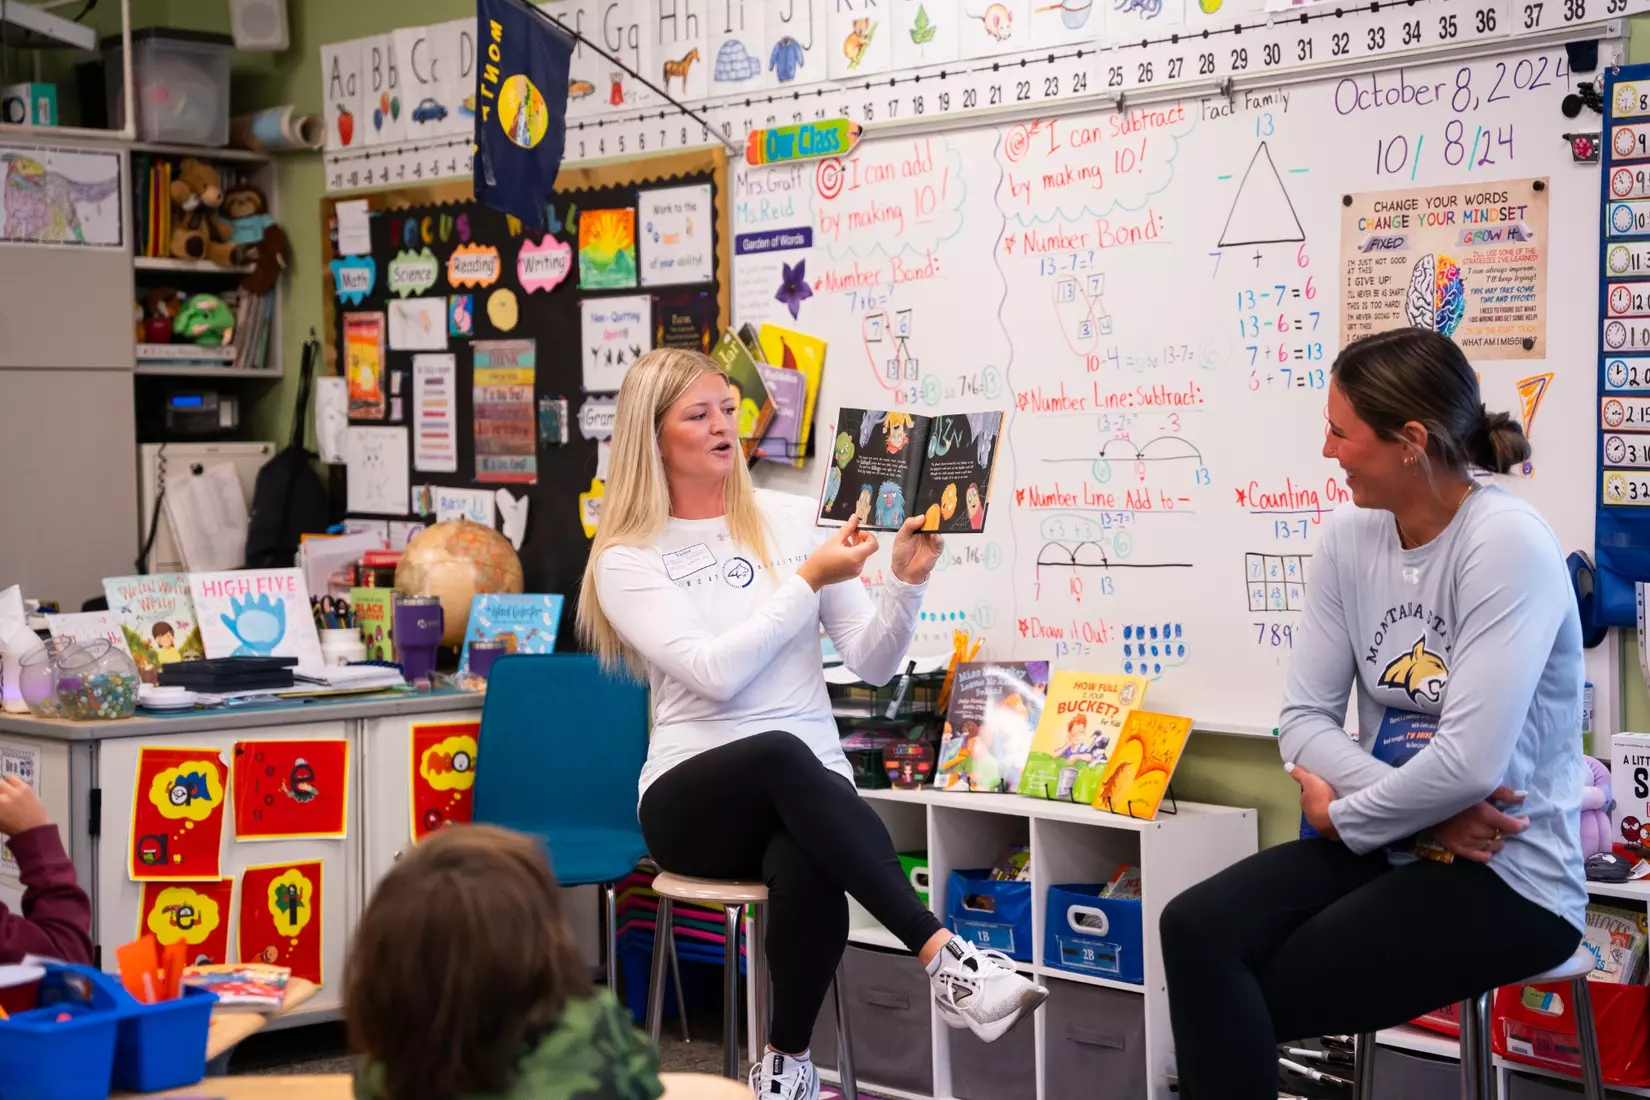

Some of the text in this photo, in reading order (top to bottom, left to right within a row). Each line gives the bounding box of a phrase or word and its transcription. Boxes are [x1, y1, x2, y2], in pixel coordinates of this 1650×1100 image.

[372, 47, 398, 92] Bb
[411, 38, 440, 85] Cc
[330, 55, 356, 98] Aa
[579, 0, 1586, 158] 3 4 5 6 7 8 9 10 16 17 18 19 20 21 22 23 24 25 26 27 28 29 30 31 32 33 34 35 36 37 38
[1335, 57, 1571, 115] October 8, 2024
[1201, 90, 1290, 121] Fact Family
[1046, 100, 1185, 156] I can Subtract
[1256, 113, 1274, 137] 13
[766, 125, 840, 160] Our Class
[848, 138, 933, 192] I can add
[1008, 137, 1148, 204] by making 10!
[766, 164, 804, 193] Graff
[652, 204, 672, 215] Work
[684, 202, 697, 213] the
[760, 195, 794, 222] Reid
[819, 166, 948, 242] by making 10!
[1374, 192, 1508, 213] CHANGE YOUR WORDS
[1358, 205, 1528, 231] CHANGE YOUR MINDSET
[743, 232, 804, 250] Garden of Words
[1023, 208, 1164, 254] Number Bond:
[1370, 236, 1404, 250] FIXED
[454, 255, 495, 276] Reading
[522, 256, 566, 279] Writing
[825, 248, 940, 290] Number Bond:
[1208, 243, 1310, 279] 7 6
[342, 274, 368, 288] Math
[393, 266, 432, 283] Science
[1355, 277, 1375, 286] GIVE
[1498, 275, 1512, 283] keep
[1462, 338, 1495, 346] WHAT AM
[1032, 380, 1204, 412] Number Line: Subtract:
[1195, 468, 1210, 485] 13
[1029, 482, 1174, 510] Number Add to
[1248, 477, 1349, 524] Counting On
[202, 575, 297, 598] HIGH FIVE
[1069, 576, 1083, 595] 10
[1101, 576, 1114, 595] 13
[355, 602, 384, 614] BLACK
[1030, 617, 1064, 640] Draw
[1366, 602, 1424, 666] MONTANA
[1073, 681, 1118, 693] HOW FULL
[1057, 700, 1119, 719] BUCKET?
[1623, 755, 1630, 764] A
[978, 931, 989, 942] 1B
[1083, 949, 1094, 960] 2B
